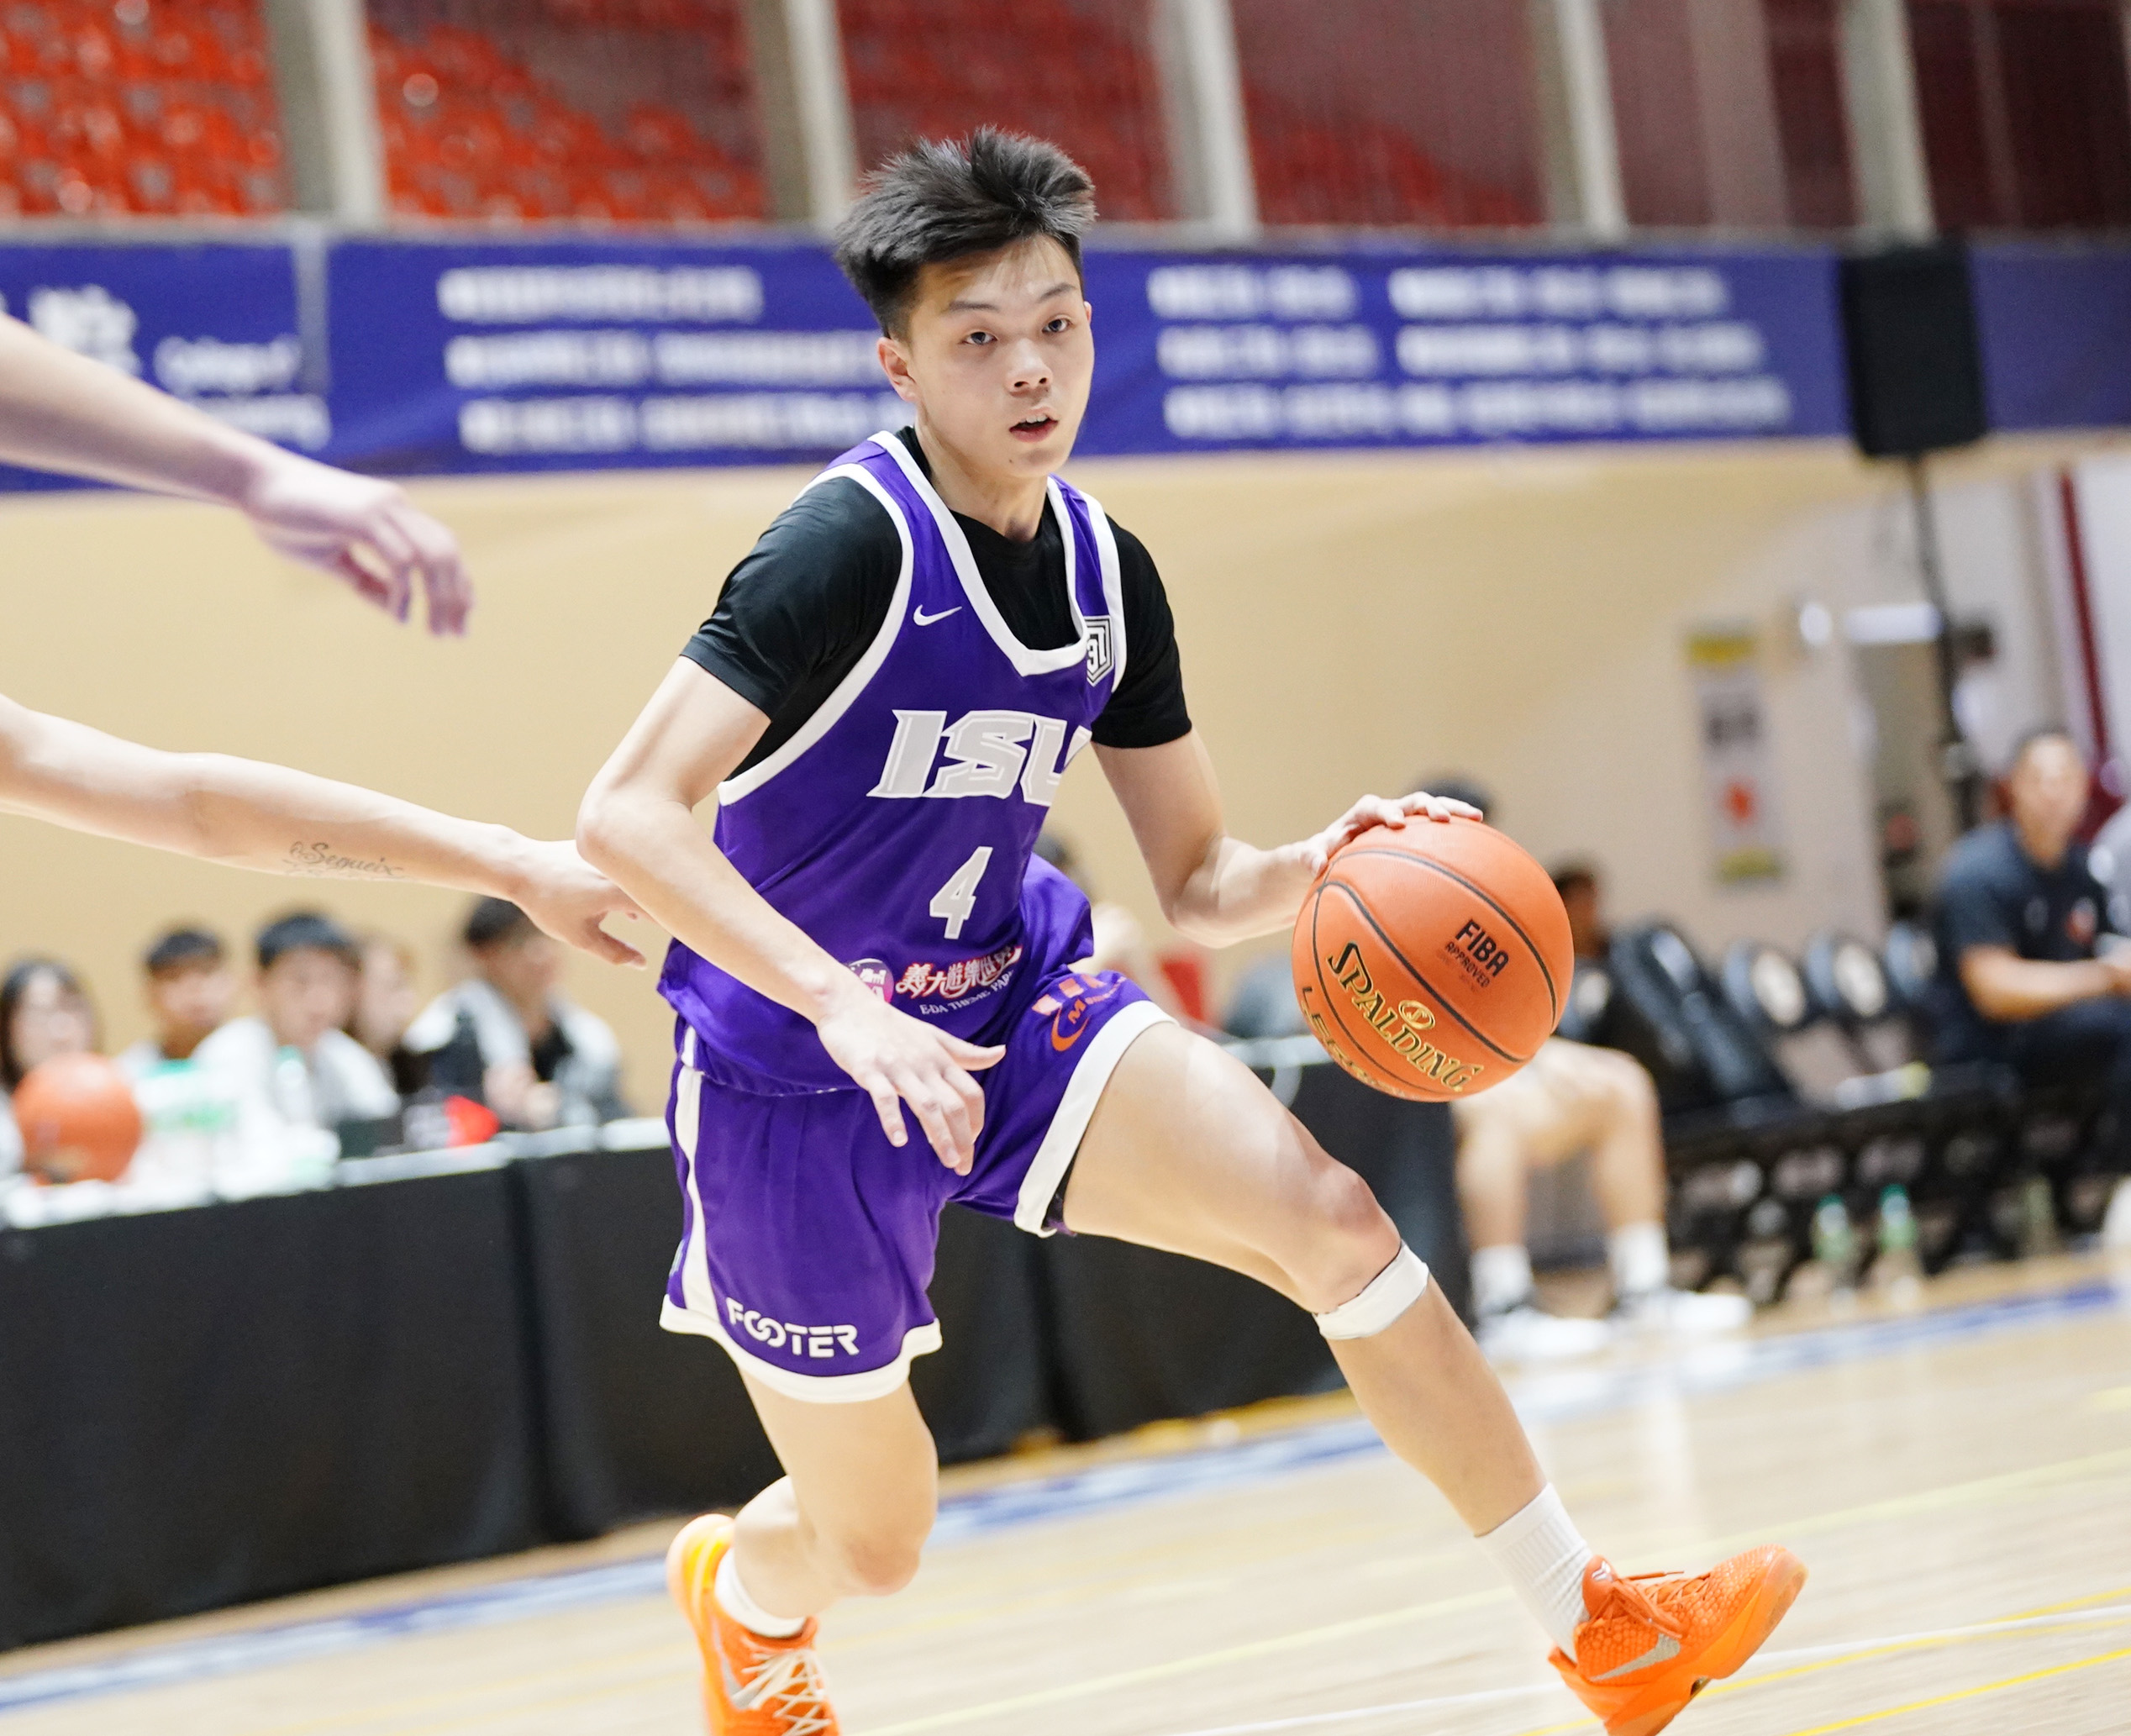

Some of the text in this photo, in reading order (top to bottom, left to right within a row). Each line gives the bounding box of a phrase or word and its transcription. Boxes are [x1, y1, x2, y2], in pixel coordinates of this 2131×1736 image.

[866, 709, 1092, 808] ISU
[929, 846, 993, 939] 4
[1445, 941, 1491, 987] APPROVED
[1455, 918, 1509, 977] FIBA
[1326, 939, 1485, 1092] SPALDING
[725, 1297, 860, 1358] FOOTER
